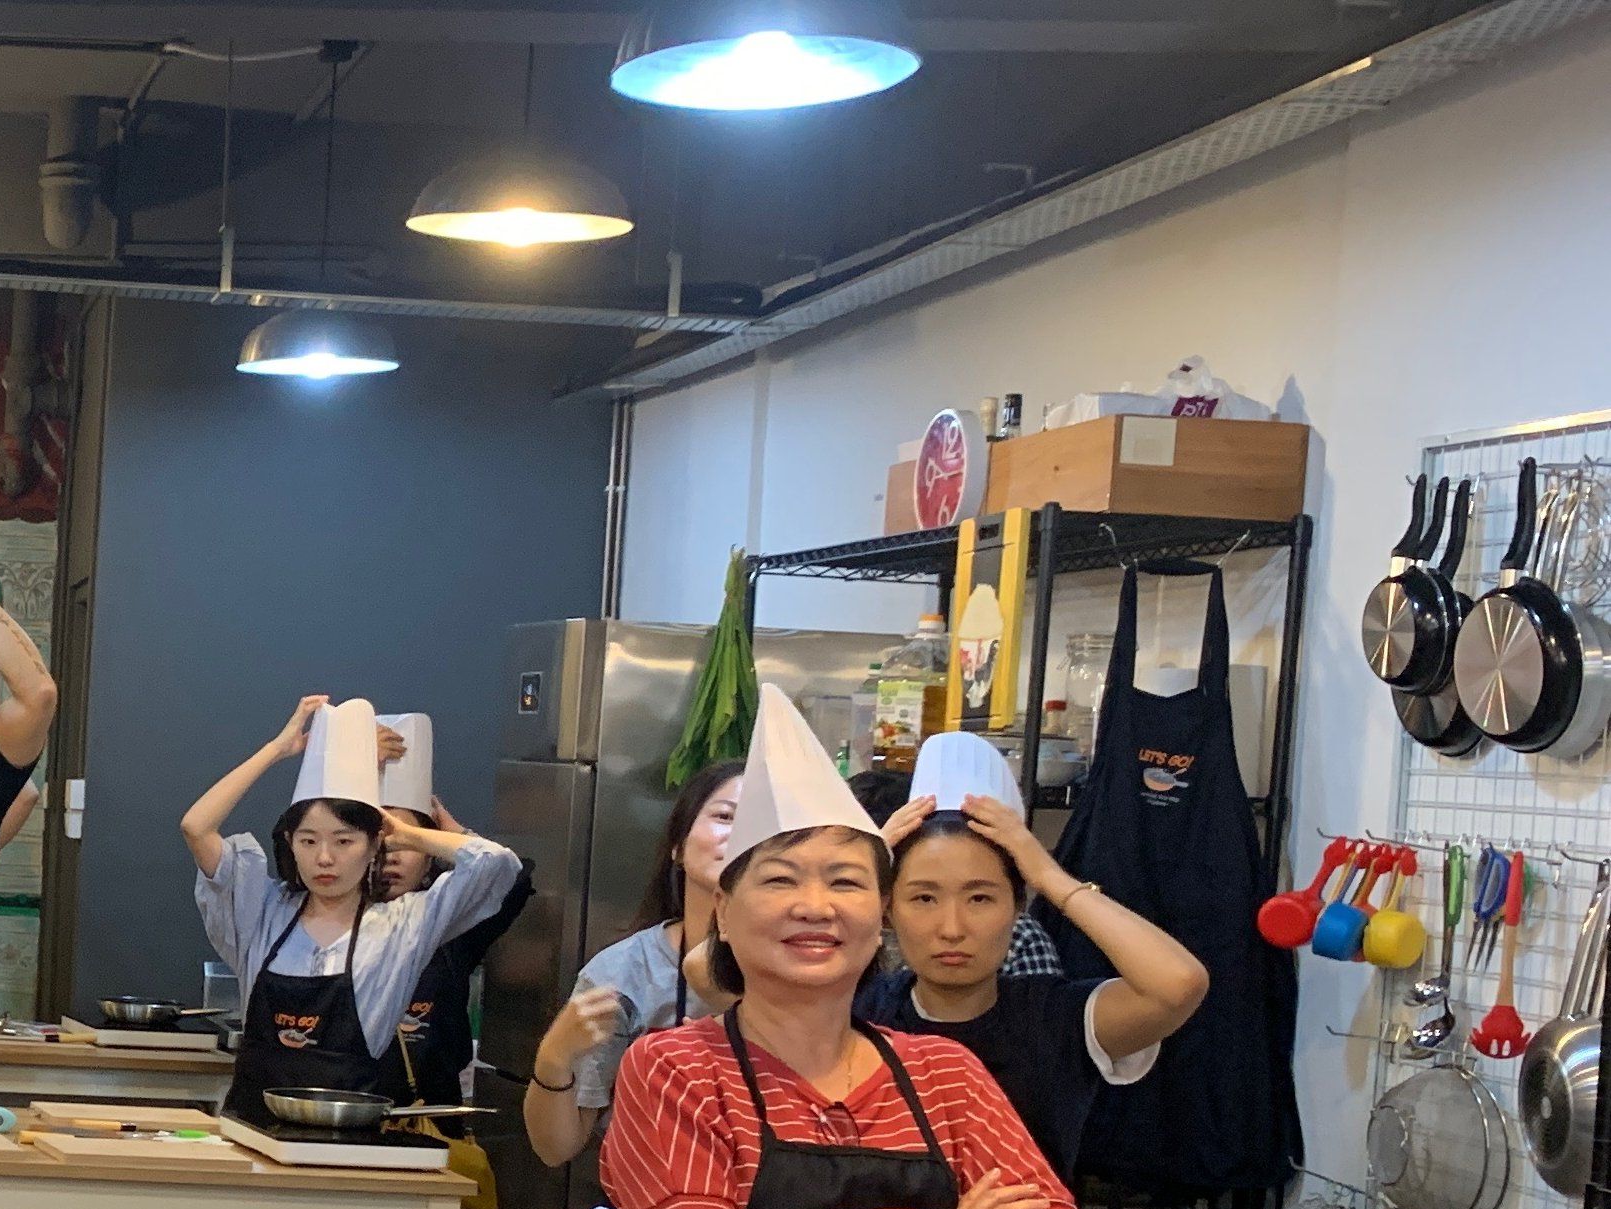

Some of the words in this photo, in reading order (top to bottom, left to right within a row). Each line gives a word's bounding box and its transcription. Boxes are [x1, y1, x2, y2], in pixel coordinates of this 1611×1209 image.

[941, 420, 965, 461] 12
[1139, 748, 1167, 765] LET'S
[1168, 755, 1195, 768] GO!
[298, 1016, 319, 1028] GO!
